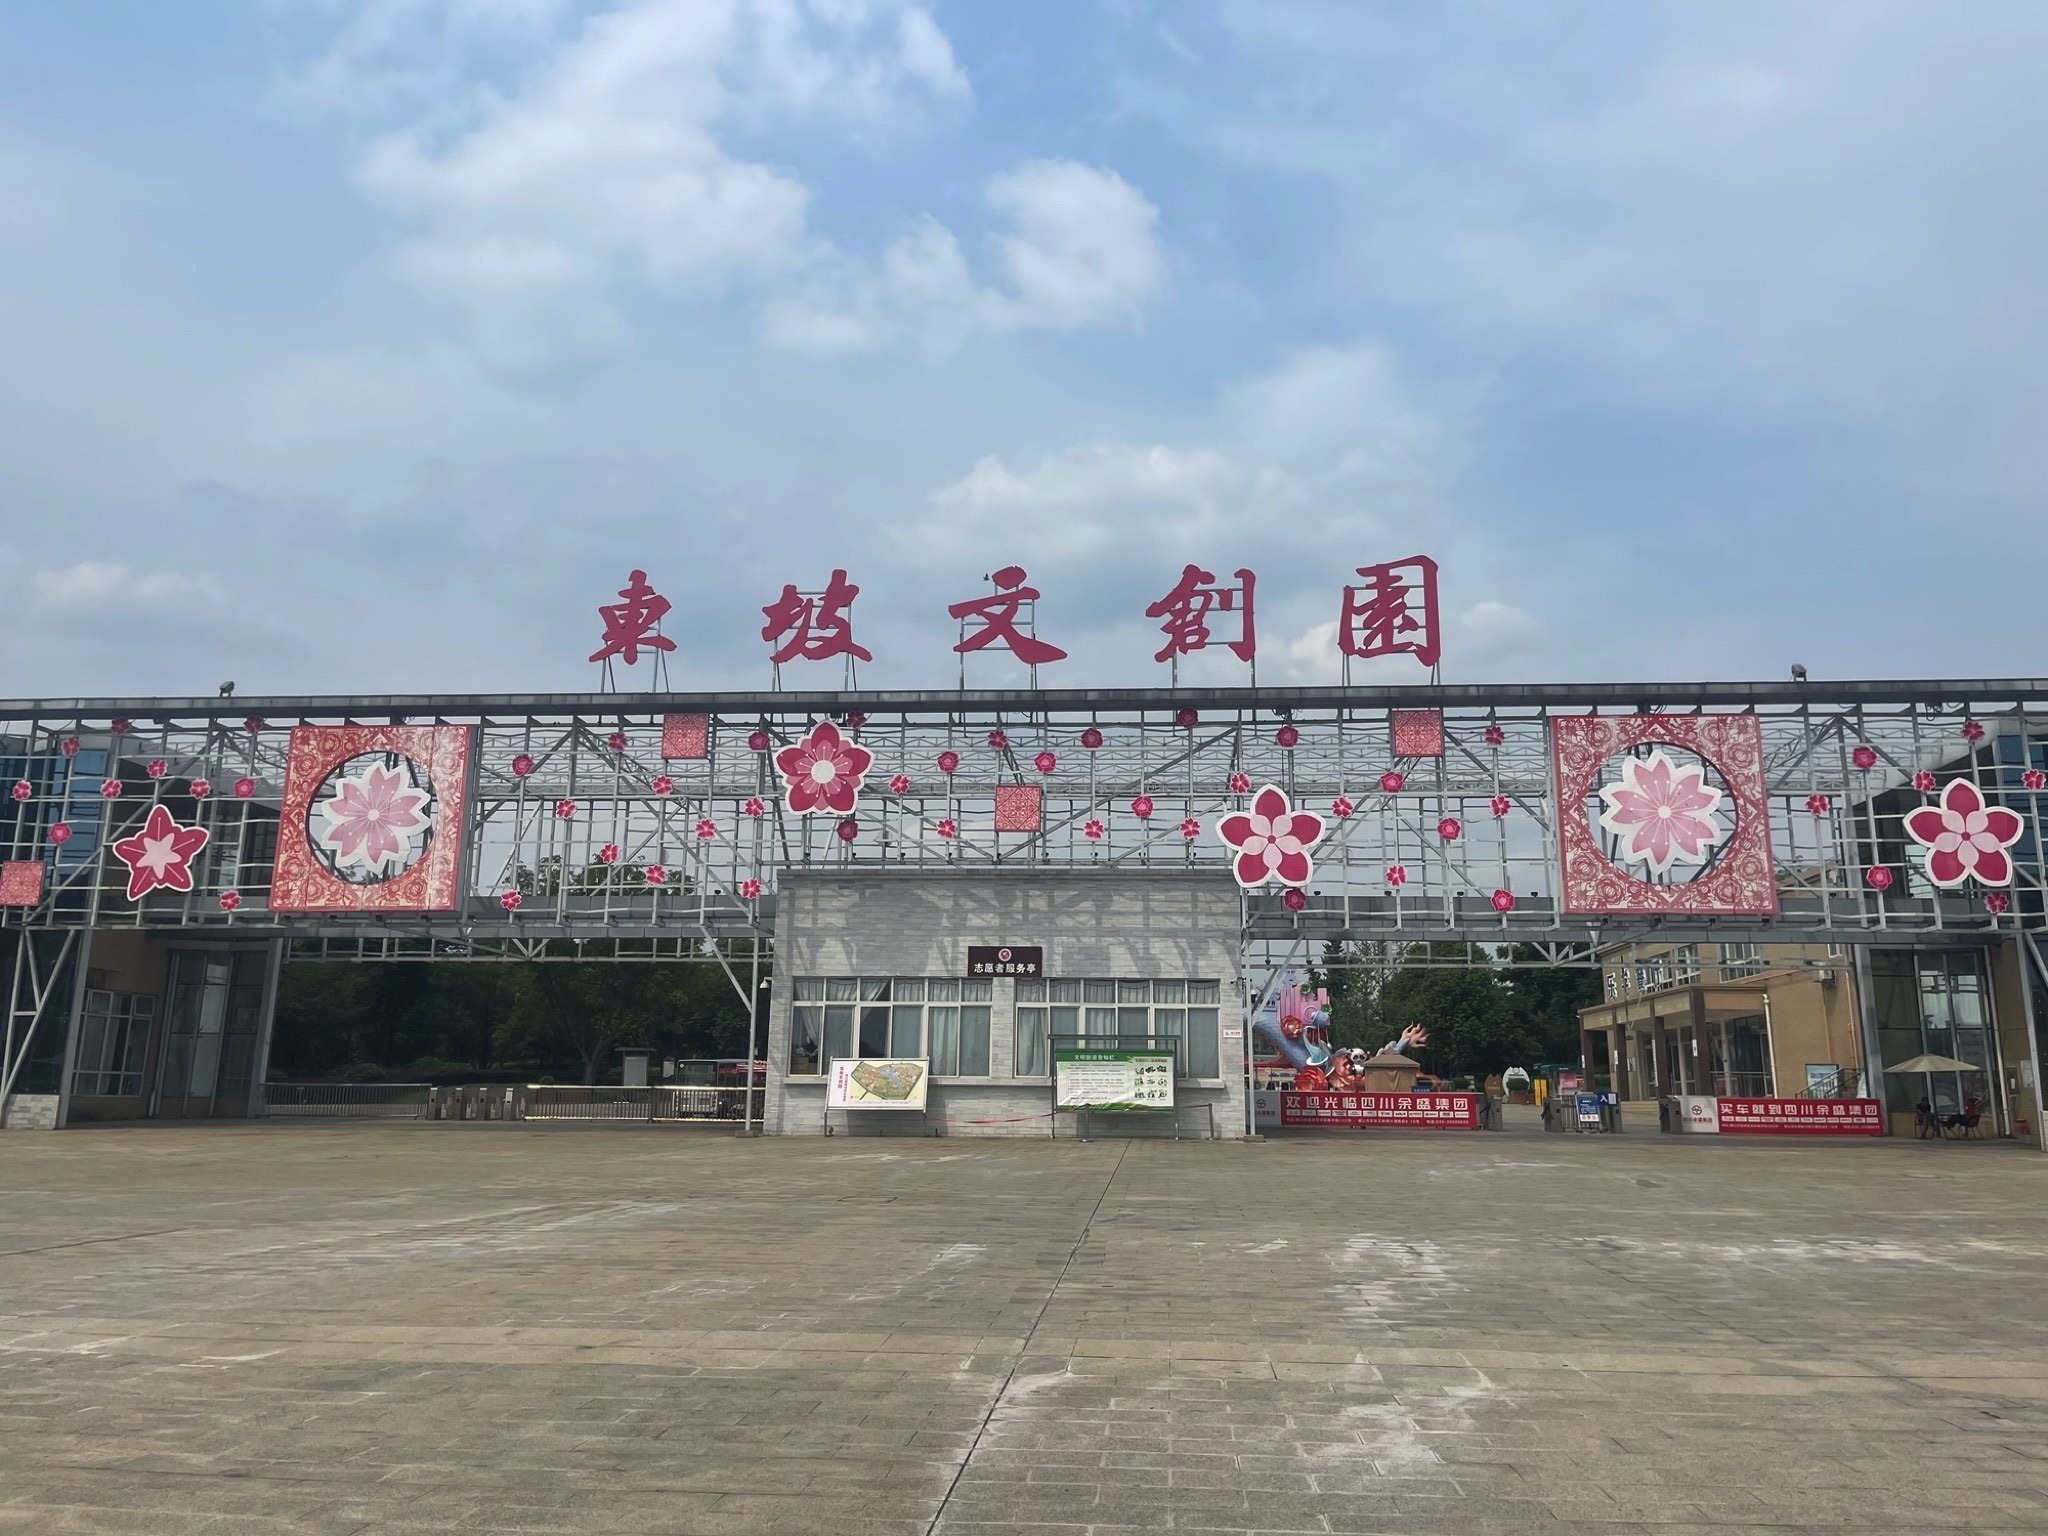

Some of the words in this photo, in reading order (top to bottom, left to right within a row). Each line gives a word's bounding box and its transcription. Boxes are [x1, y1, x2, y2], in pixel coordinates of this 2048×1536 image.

[588, 554, 1439, 668] 東坡文創園
[974, 962, 1036, 974] 志愿者服务亭
[1286, 1096, 1468, 1111] 欢迎光临四川余盛集团
[1720, 1103, 1878, 1115] 买车就到四川余盛集团
